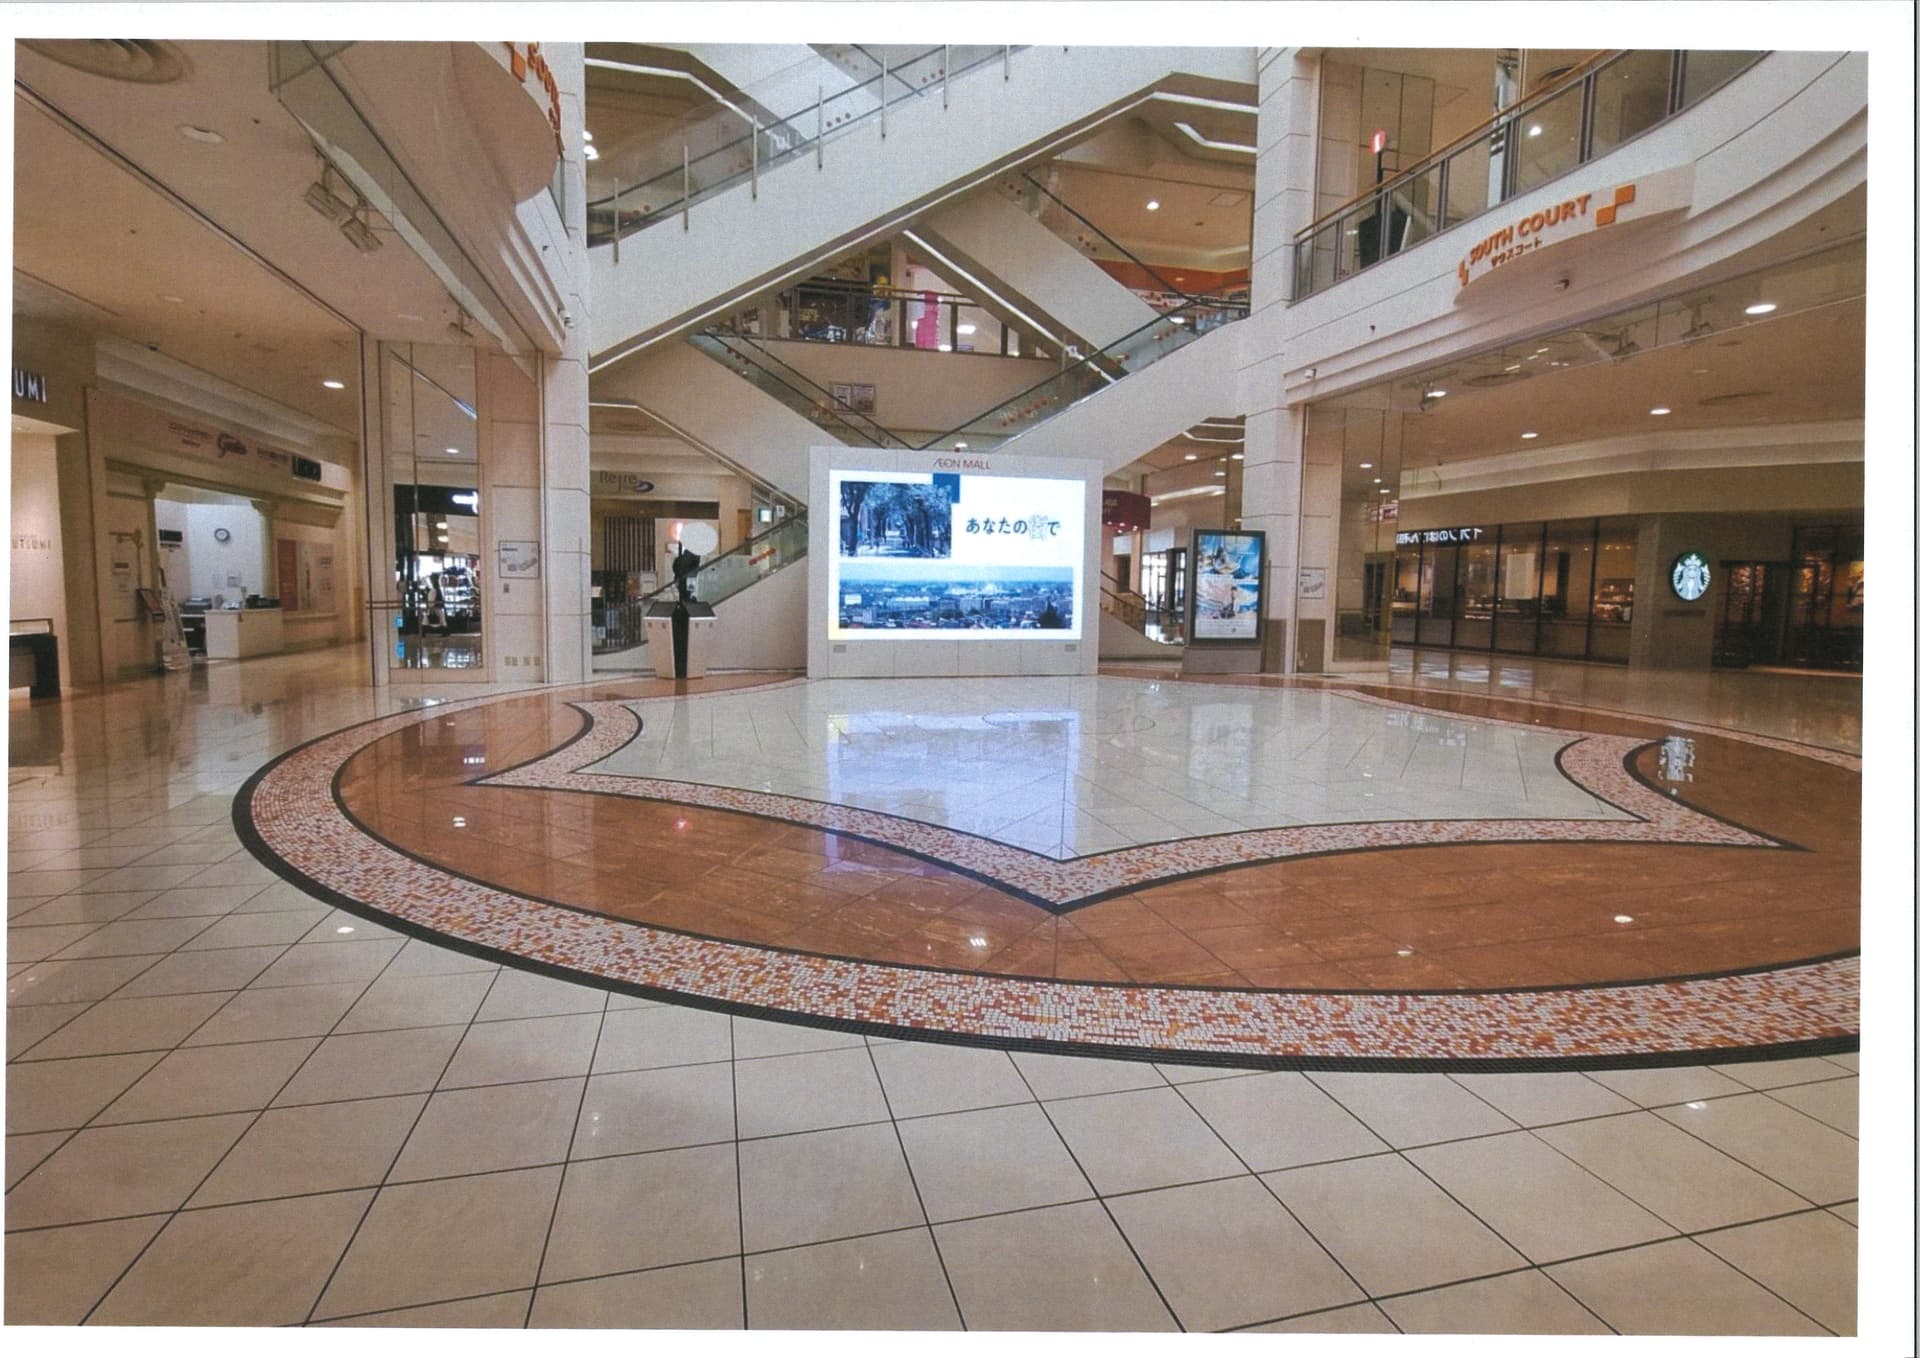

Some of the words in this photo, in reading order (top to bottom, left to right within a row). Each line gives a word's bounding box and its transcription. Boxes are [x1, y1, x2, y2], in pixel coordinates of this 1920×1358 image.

[1470, 225, 1513, 265] SOUTH
[1518, 193, 1591, 237] COURT
[1491, 237, 1543, 266] サウスコート
[963, 460, 992, 469] MALL
